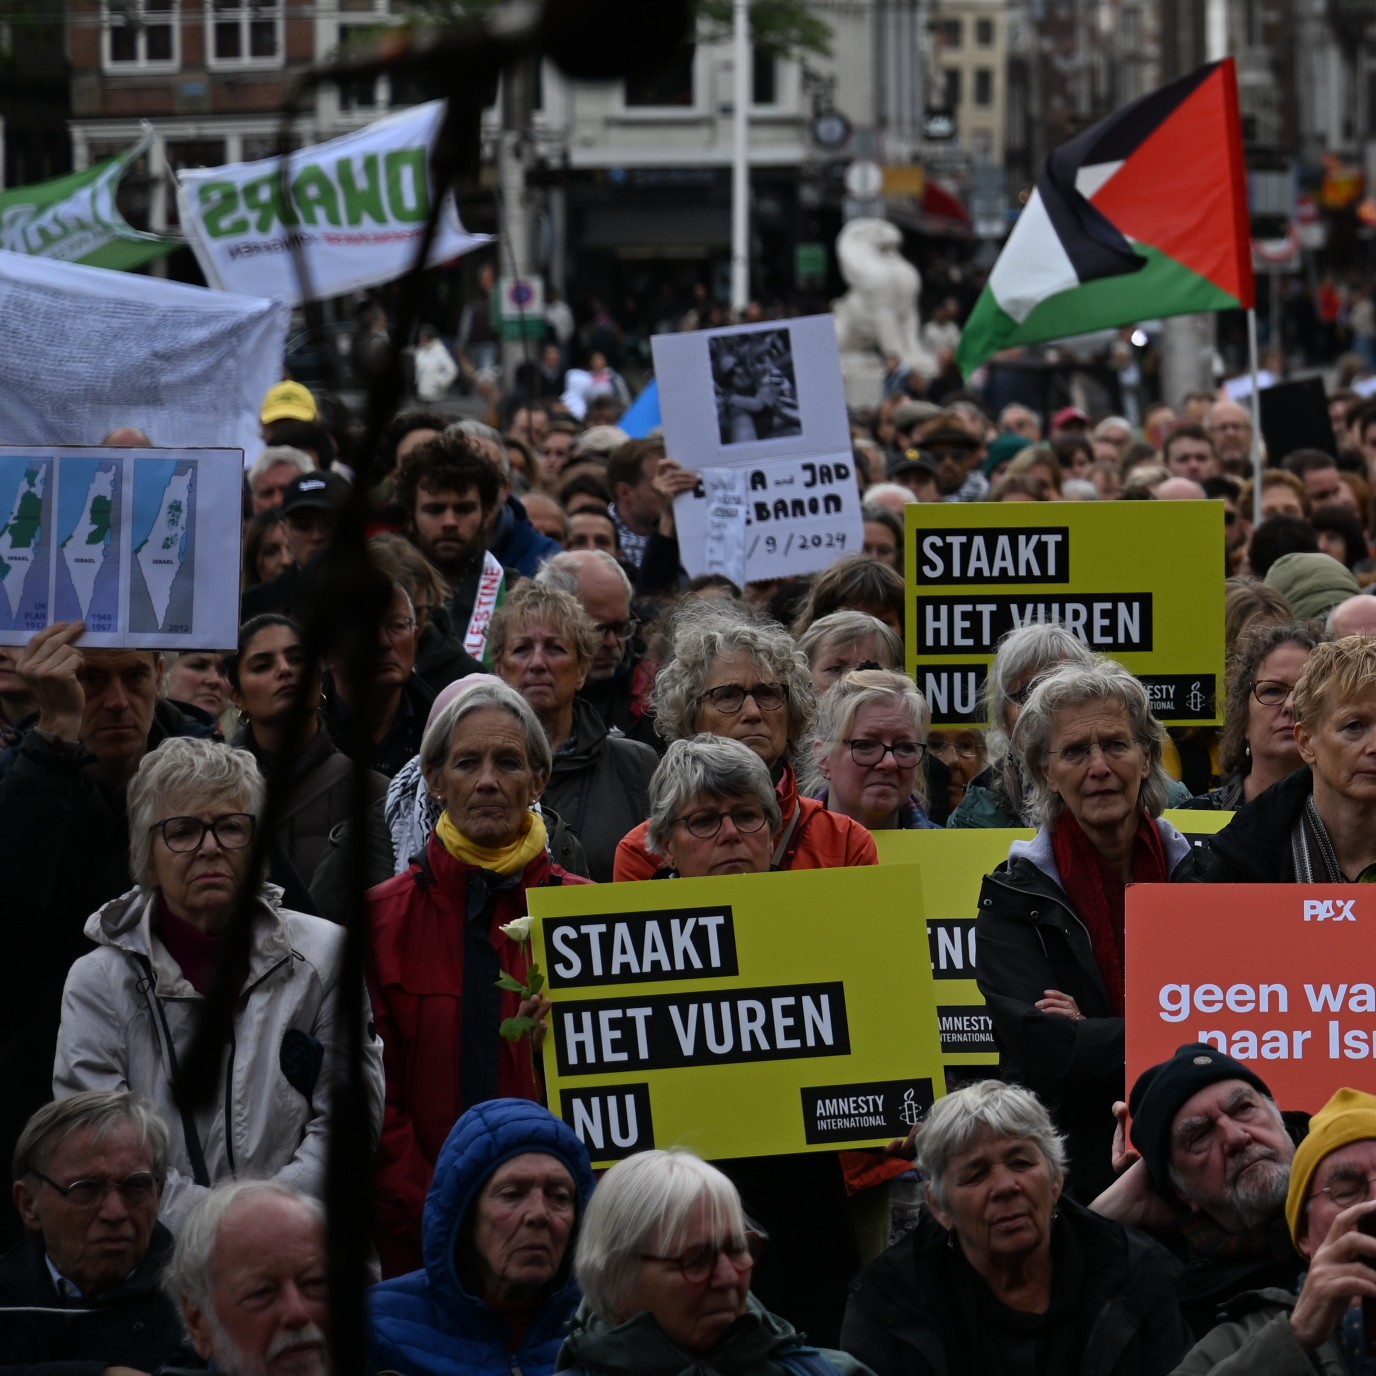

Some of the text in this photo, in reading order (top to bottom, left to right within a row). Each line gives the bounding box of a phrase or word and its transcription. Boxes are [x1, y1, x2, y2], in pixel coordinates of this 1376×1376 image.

[801, 462, 851, 488] JAD
[921, 534, 1063, 579] STAAKT
[24, 612, 47, 621] PLAN
[34, 602, 47, 611] UN
[168, 624, 189, 633] 2012
[925, 604, 997, 646] HET
[926, 672, 977, 714] NU
[1147, 684, 1176, 699] ESTY
[1303, 899, 1357, 922] PAX
[551, 914, 725, 979] STAAKT
[1158, 982, 1289, 1023] geen
[563, 993, 835, 1065] HET VUREN
[1197, 1029, 1312, 1060] naar
[815, 1094, 886, 1117] AMNESTY
[571, 1093, 639, 1149] NU
[816, 1114, 887, 1131] INTERNATIONAL
